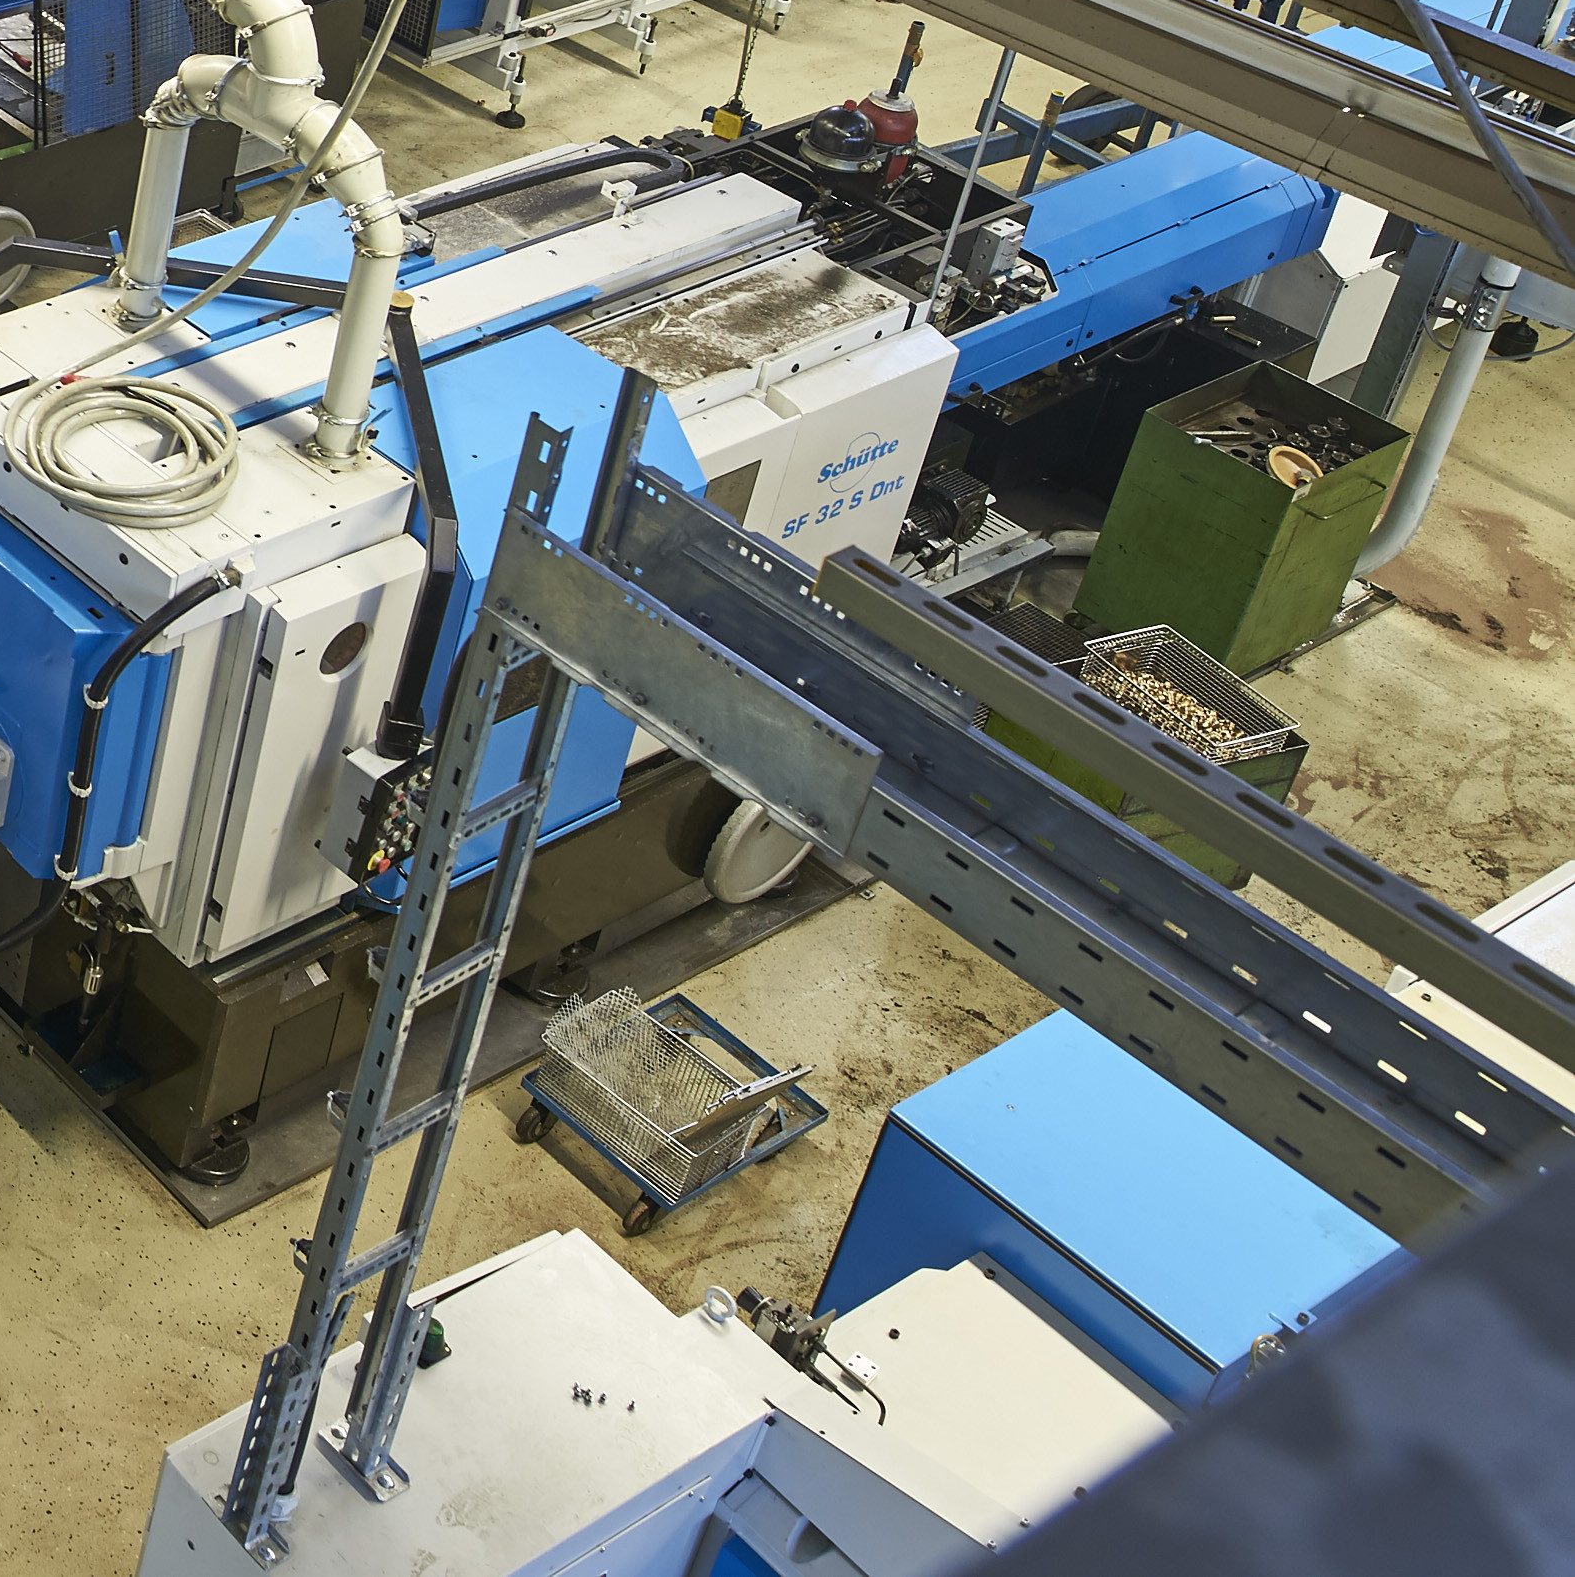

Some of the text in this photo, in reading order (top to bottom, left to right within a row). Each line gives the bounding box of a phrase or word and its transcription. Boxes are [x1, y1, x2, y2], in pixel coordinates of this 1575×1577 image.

[817, 439, 900, 484] Schütte
[781, 475, 905, 539] SF 32 S Dnt
